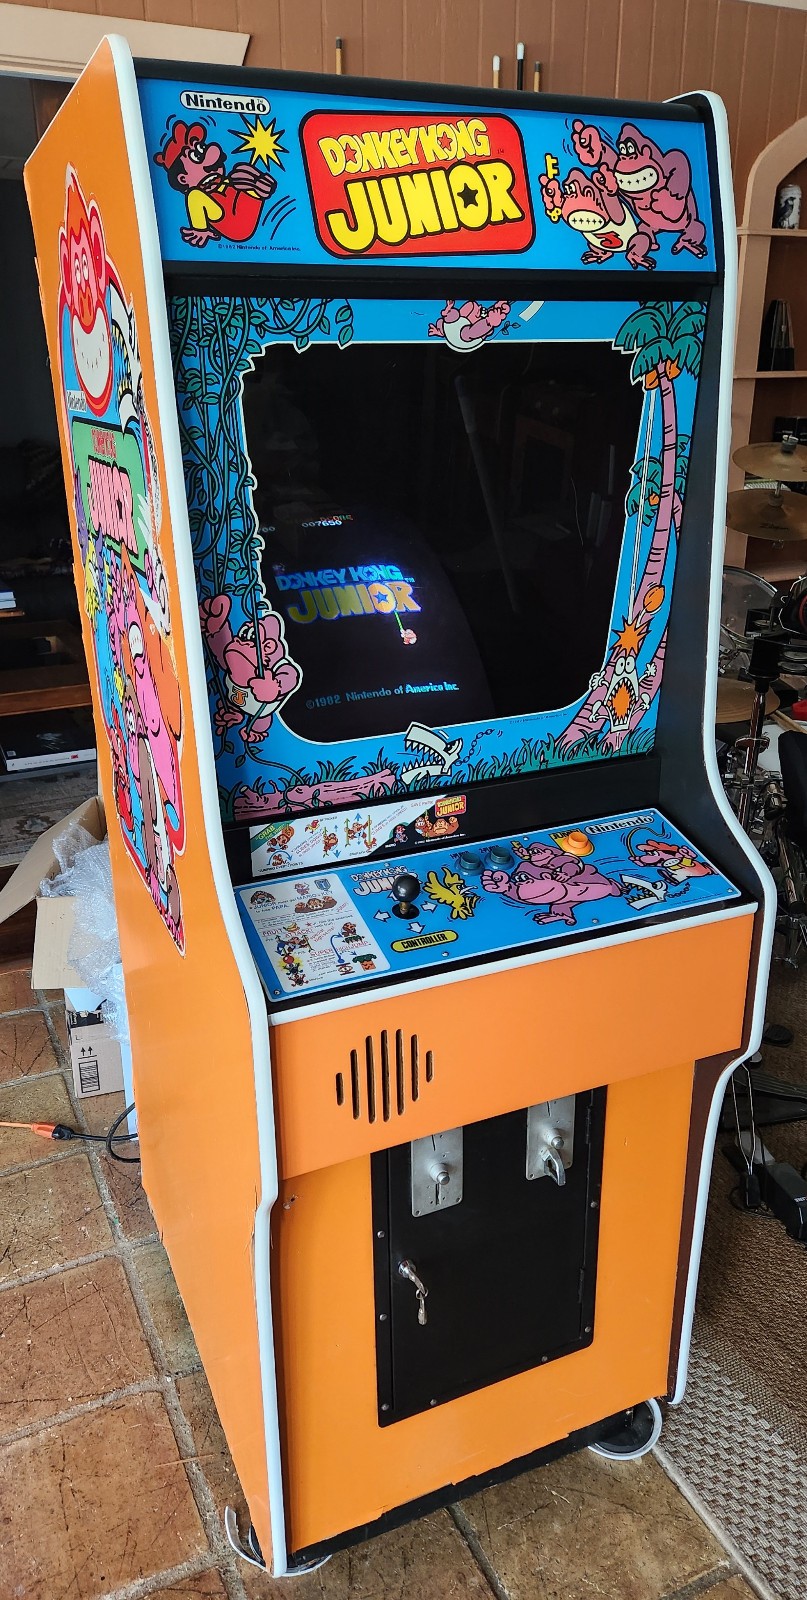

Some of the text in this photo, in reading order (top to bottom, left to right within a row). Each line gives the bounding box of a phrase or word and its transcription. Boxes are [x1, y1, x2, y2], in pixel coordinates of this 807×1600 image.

[184, 92, 268, 113] Nintendo
[317, 117, 491, 177] DONKEY KONG
[325, 159, 526, 255] JUNIOR
[301, 519, 343, 529] 007650
[275, 567, 348, 592] DONKEY
[348, 563, 404, 584] KONG
[287, 581, 422, 624] JUNIOR
[345, 687, 392, 703] Nintendo
[394, 684, 404, 694] of
[405, 682, 444, 695] America
[589, 816, 652, 835] Nintendo
[401, 933, 448, 949] CONTROLLER
